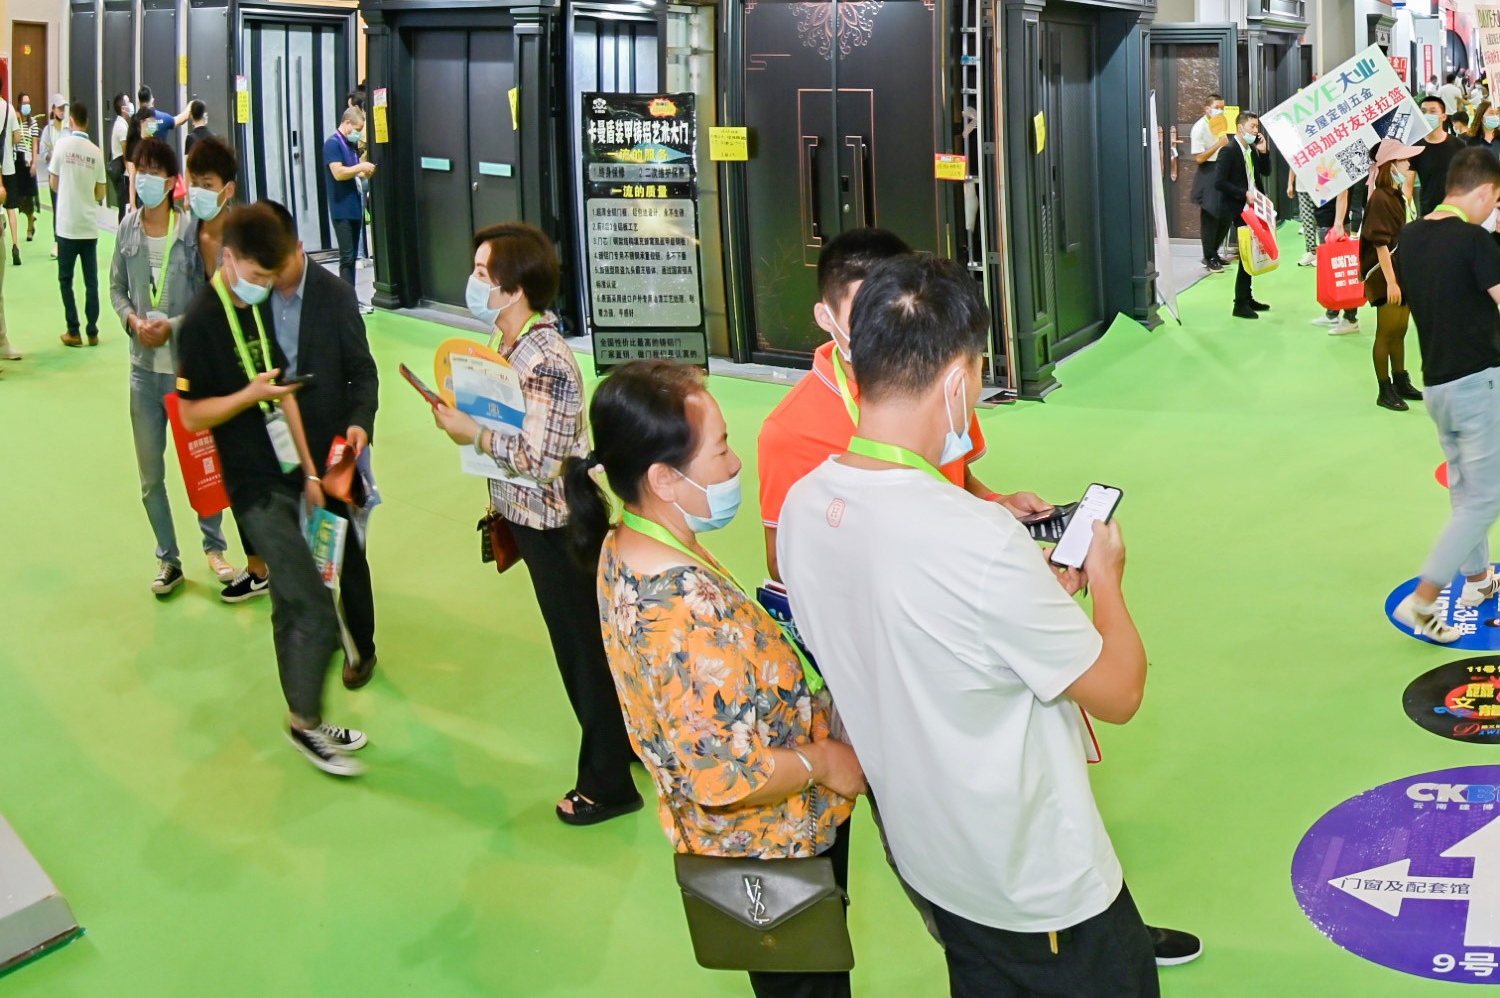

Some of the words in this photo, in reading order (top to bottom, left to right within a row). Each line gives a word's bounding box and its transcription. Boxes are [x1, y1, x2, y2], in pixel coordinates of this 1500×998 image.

[1293, 85, 1406, 169] 扫码加好友送拉篮
[1304, 87, 1374, 137] 全屋定制五金
[611, 185, 668, 198] 一流的质量
[1341, 876, 1471, 895] 门窗及配套馆
